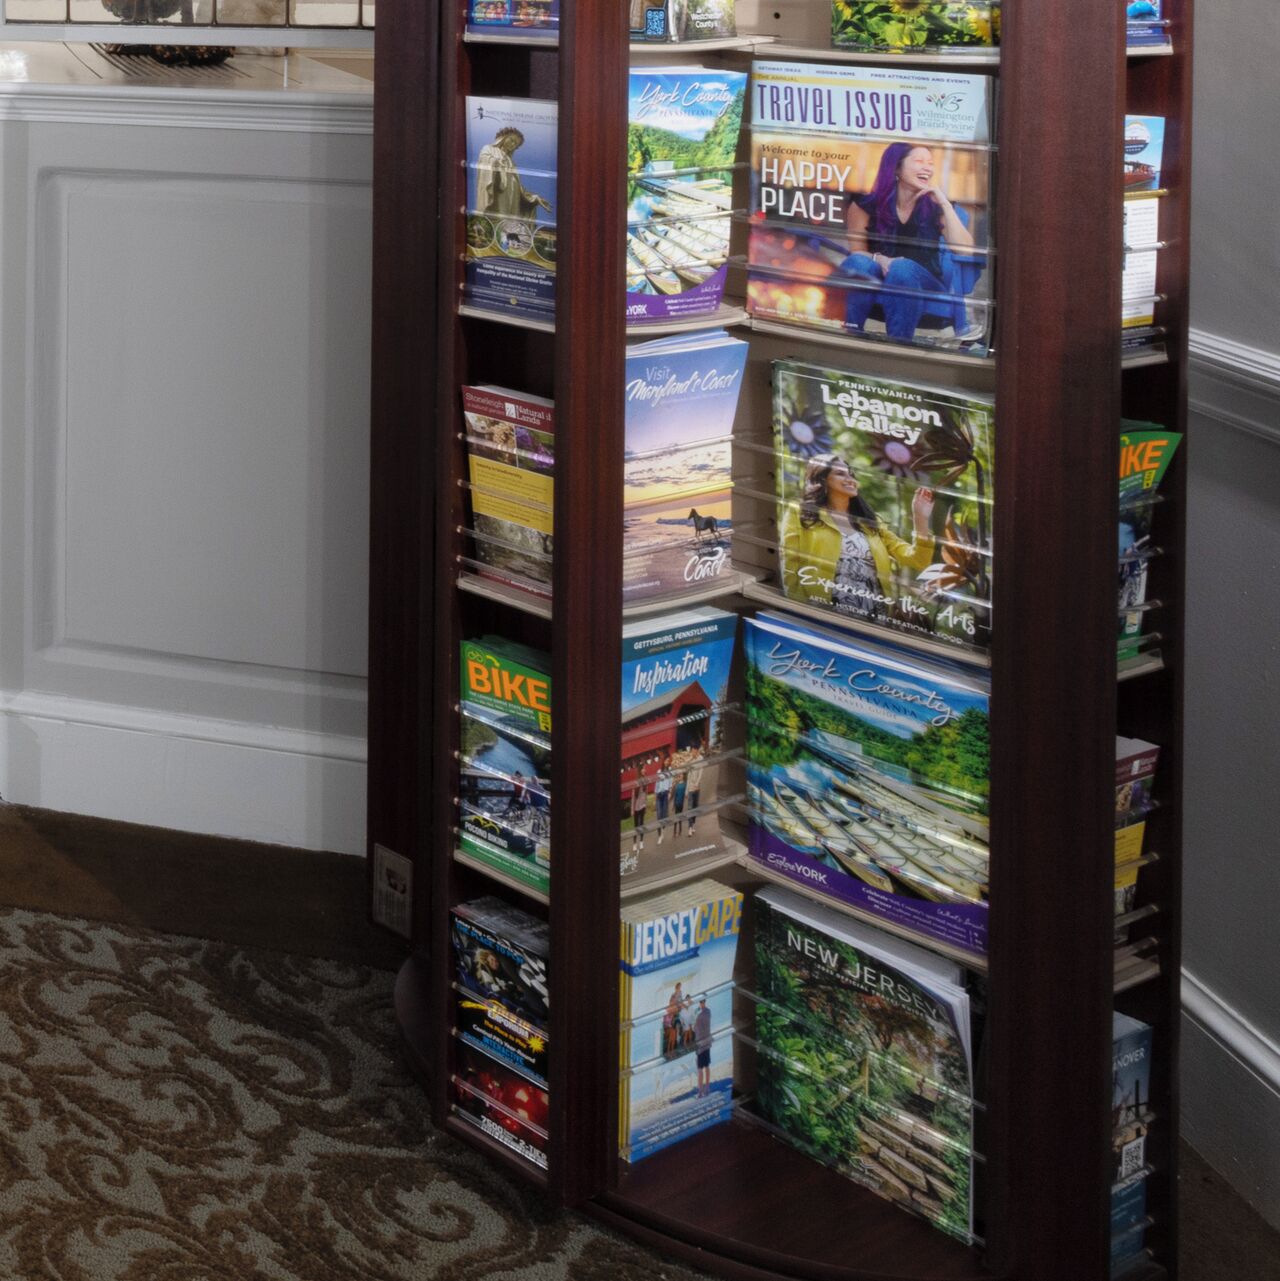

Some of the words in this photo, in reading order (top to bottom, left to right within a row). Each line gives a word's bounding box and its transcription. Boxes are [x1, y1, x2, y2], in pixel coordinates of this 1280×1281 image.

[888, 74, 930, 82] ATTRACTIONS
[946, 77, 971, 85] EVENTS
[682, 82, 734, 118] County
[917, 109, 975, 122] Wilmington
[917, 120, 975, 131] Brandywine
[761, 144, 808, 157] Welcome
[810, 149, 821, 158] to
[823, 151, 851, 161] your
[761, 156, 853, 192] HAPPY
[761, 187, 844, 224] PLACE
[646, 366, 670, 381] Visit
[838, 380, 923, 402] PENNSYLVANIA'S
[820, 384, 943, 427] Lebanon
[839, 407, 921, 445] Valley
[797, 565, 896, 605] Experience
[899, 595, 929, 616] the
[936, 604, 976, 636] Arts
[836, 602, 869, 616] HISTORY
[877, 614, 928, 634] RECREATION
[675, 625, 718, 640] PENNSYLVANIA
[467, 659, 551, 714] BIKE
[633, 651, 709, 697] Inspiration
[768, 641, 841, 676] York
[848, 669, 959, 727] County
[787, 930, 838, 967] NEW
[847, 962, 939, 1020] JERSEY
